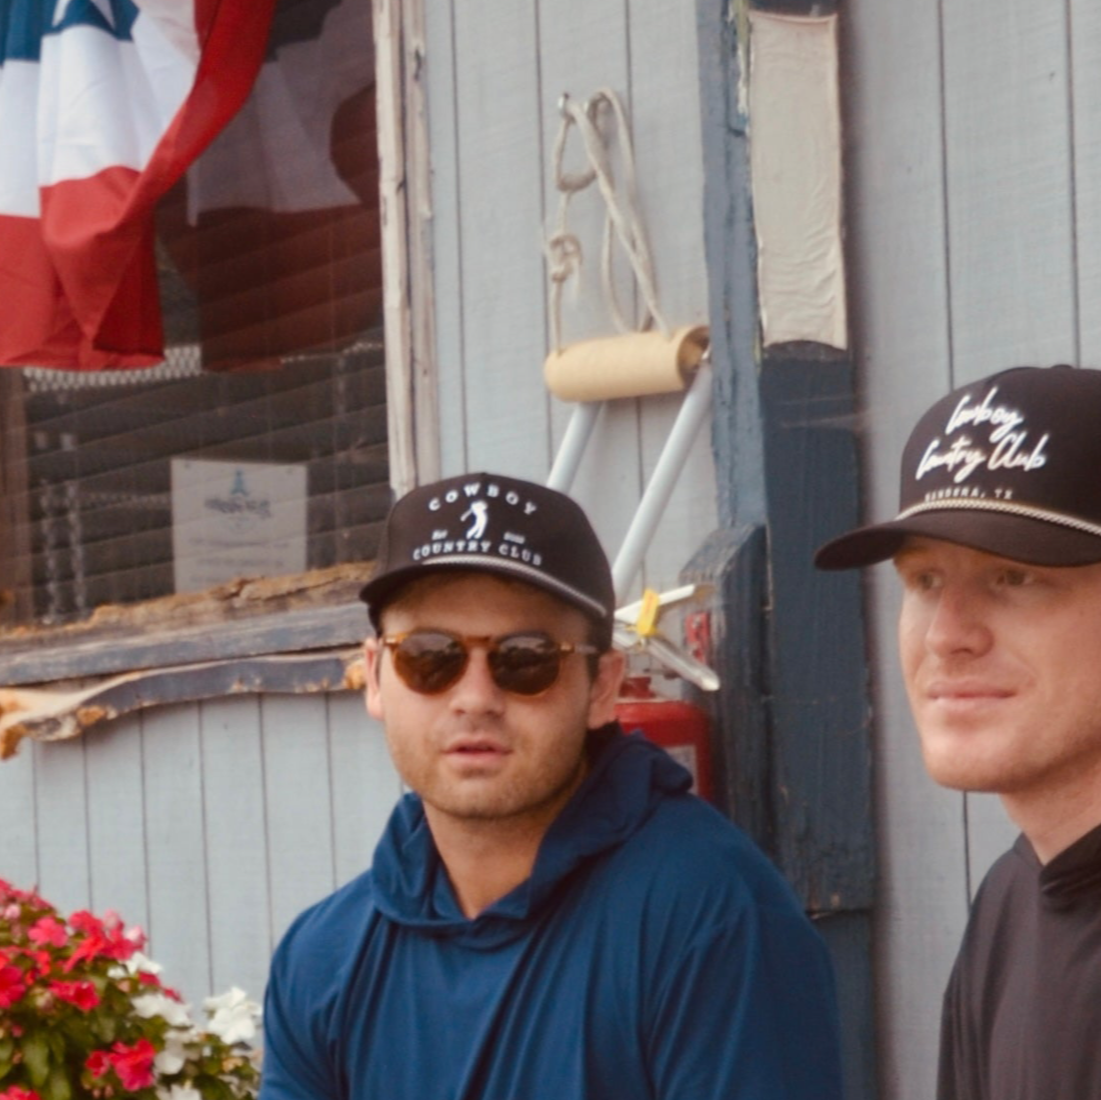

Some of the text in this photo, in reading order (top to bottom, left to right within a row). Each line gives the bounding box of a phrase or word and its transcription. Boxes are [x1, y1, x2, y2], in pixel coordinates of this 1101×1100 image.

[987, 431, 1049, 471] Club
[428, 482, 537, 515] COWBOY
[413, 540, 542, 566] COUNTRY CLUB
